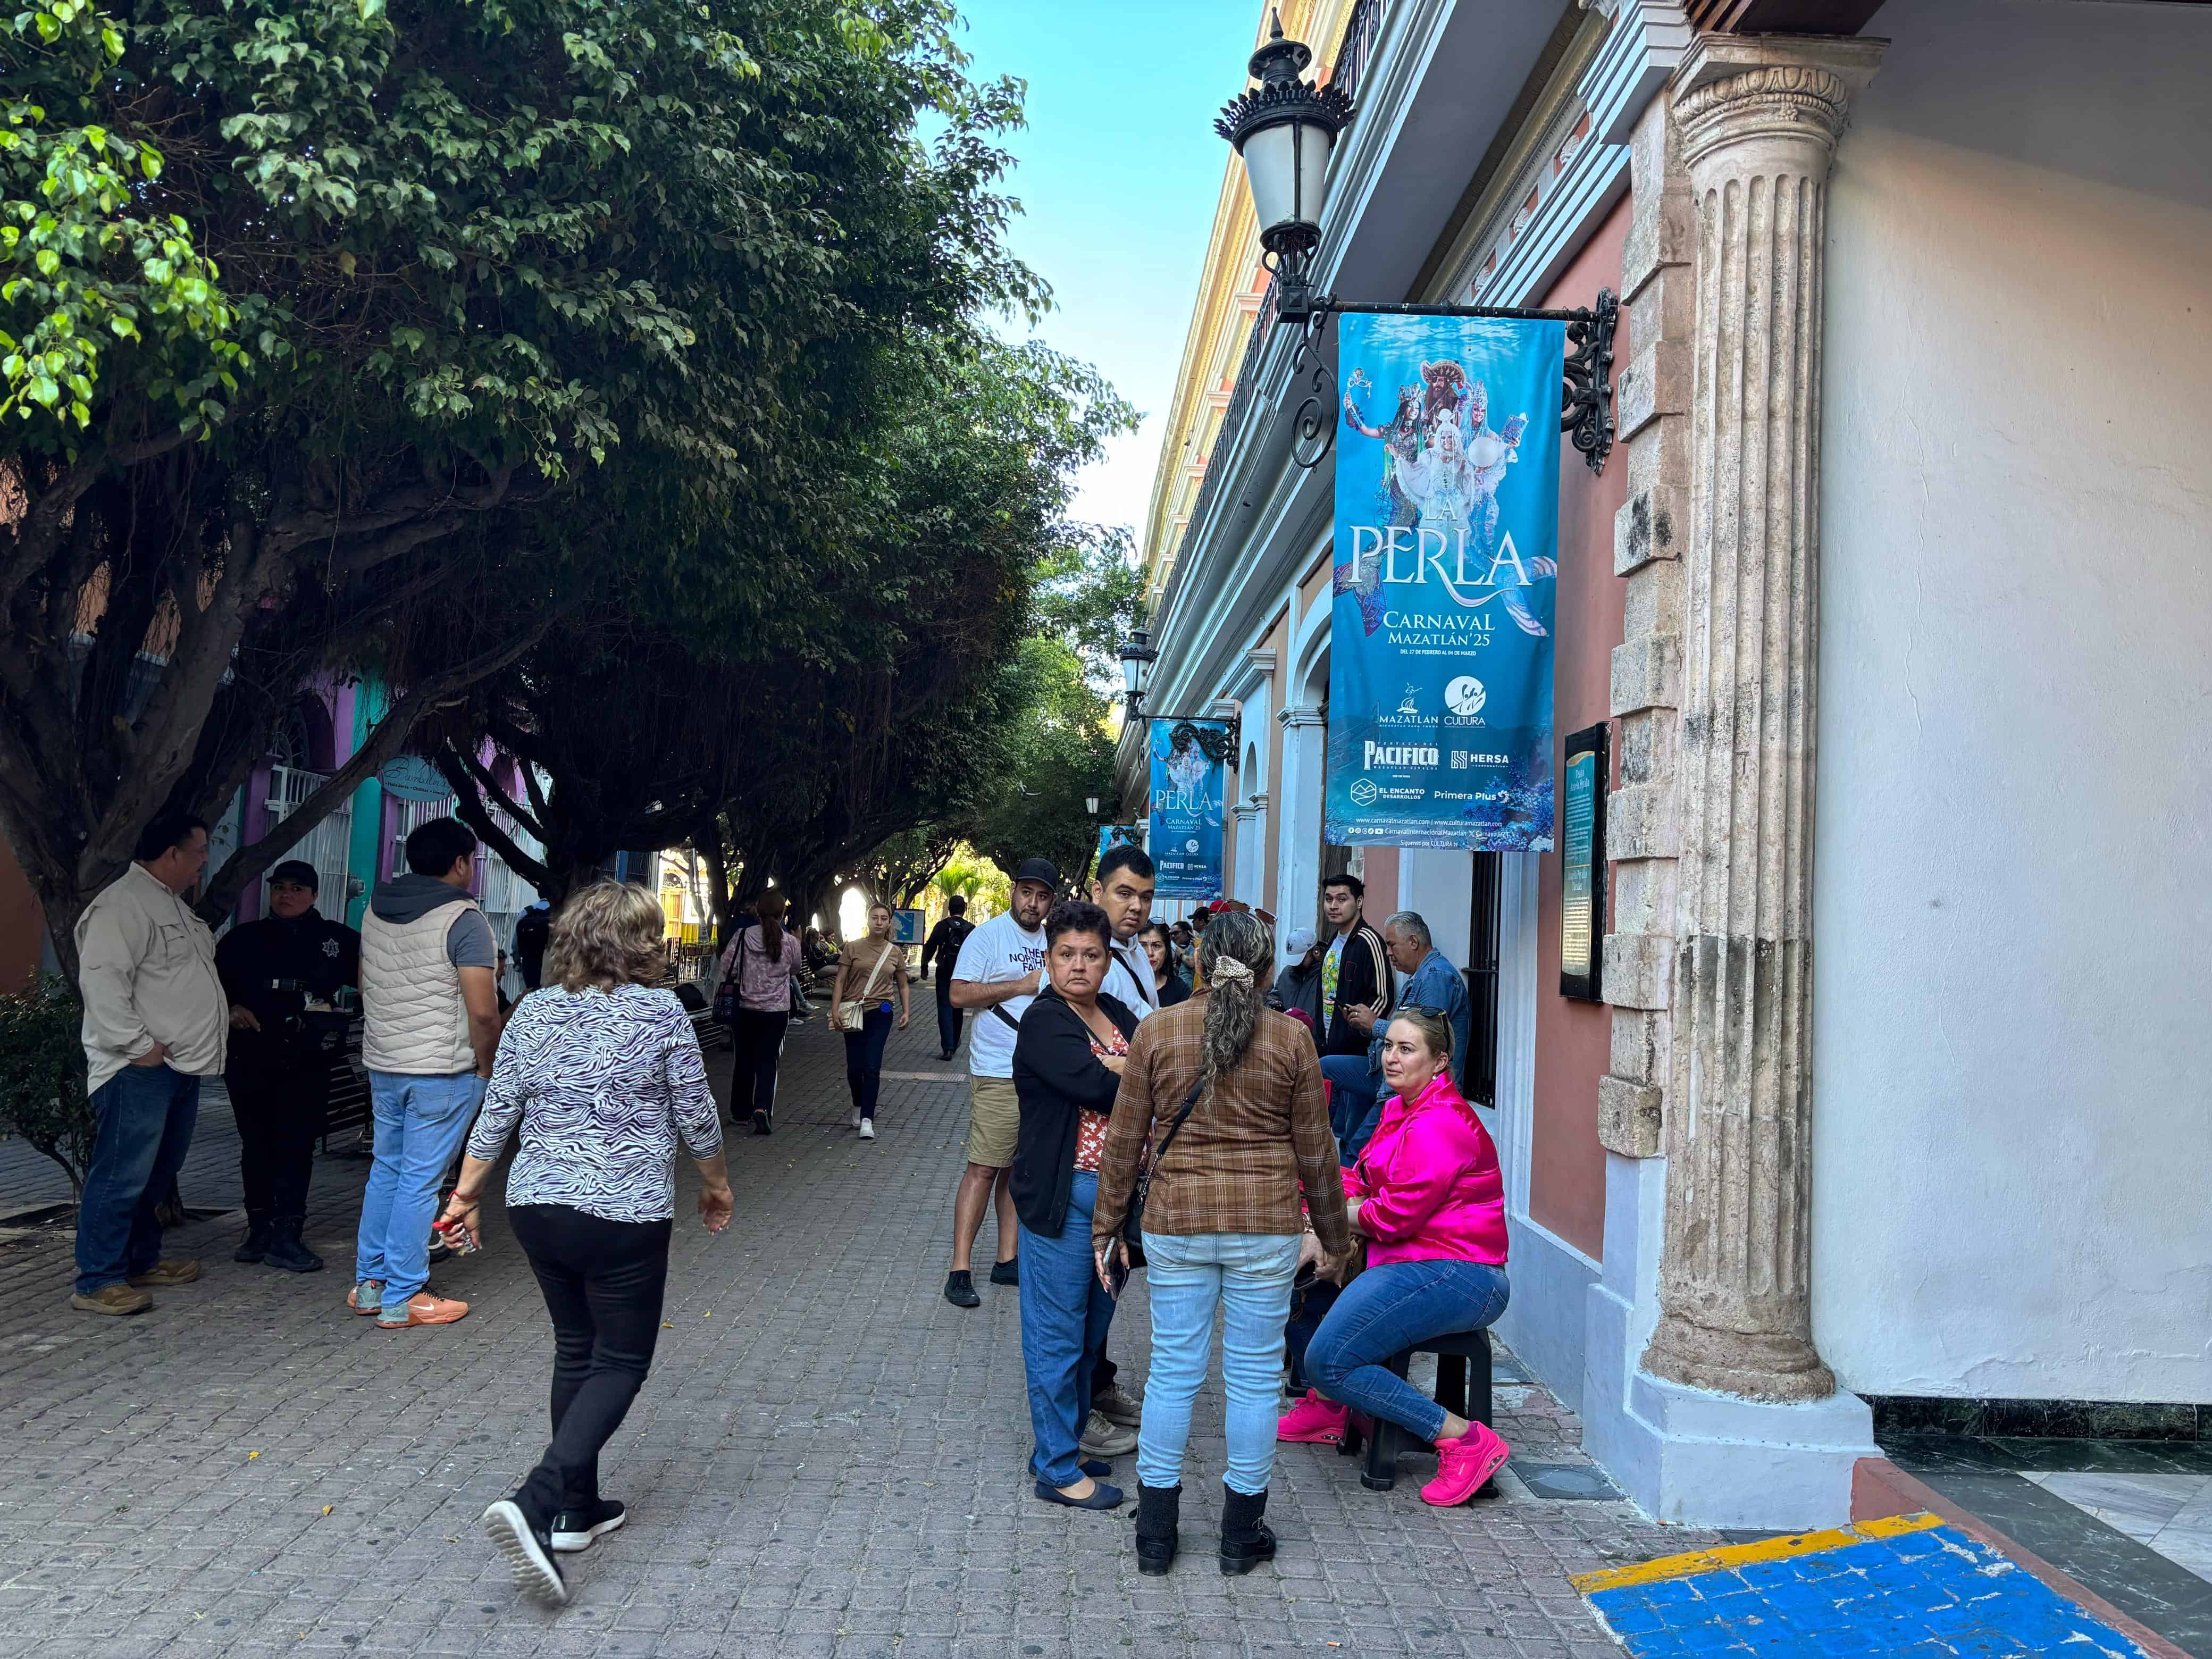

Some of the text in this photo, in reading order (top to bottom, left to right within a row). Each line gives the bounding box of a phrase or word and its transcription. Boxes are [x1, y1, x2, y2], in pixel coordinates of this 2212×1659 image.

[1425, 497, 1457, 521] LA
[1348, 525, 1532, 607] PERLA
[1383, 611, 1495, 631] CARNAVAL
[1379, 714, 1438, 724] MAZATLÁN
[1444, 716, 1486, 726] CULTURA
[1364, 740, 1439, 770] PACIFICO
[1470, 753, 1510, 764] HERSA
[1155, 790, 1213, 817] PERLA
[1434, 791, 1497, 801] Primera Plus
[1022, 946, 1040, 958] THE
